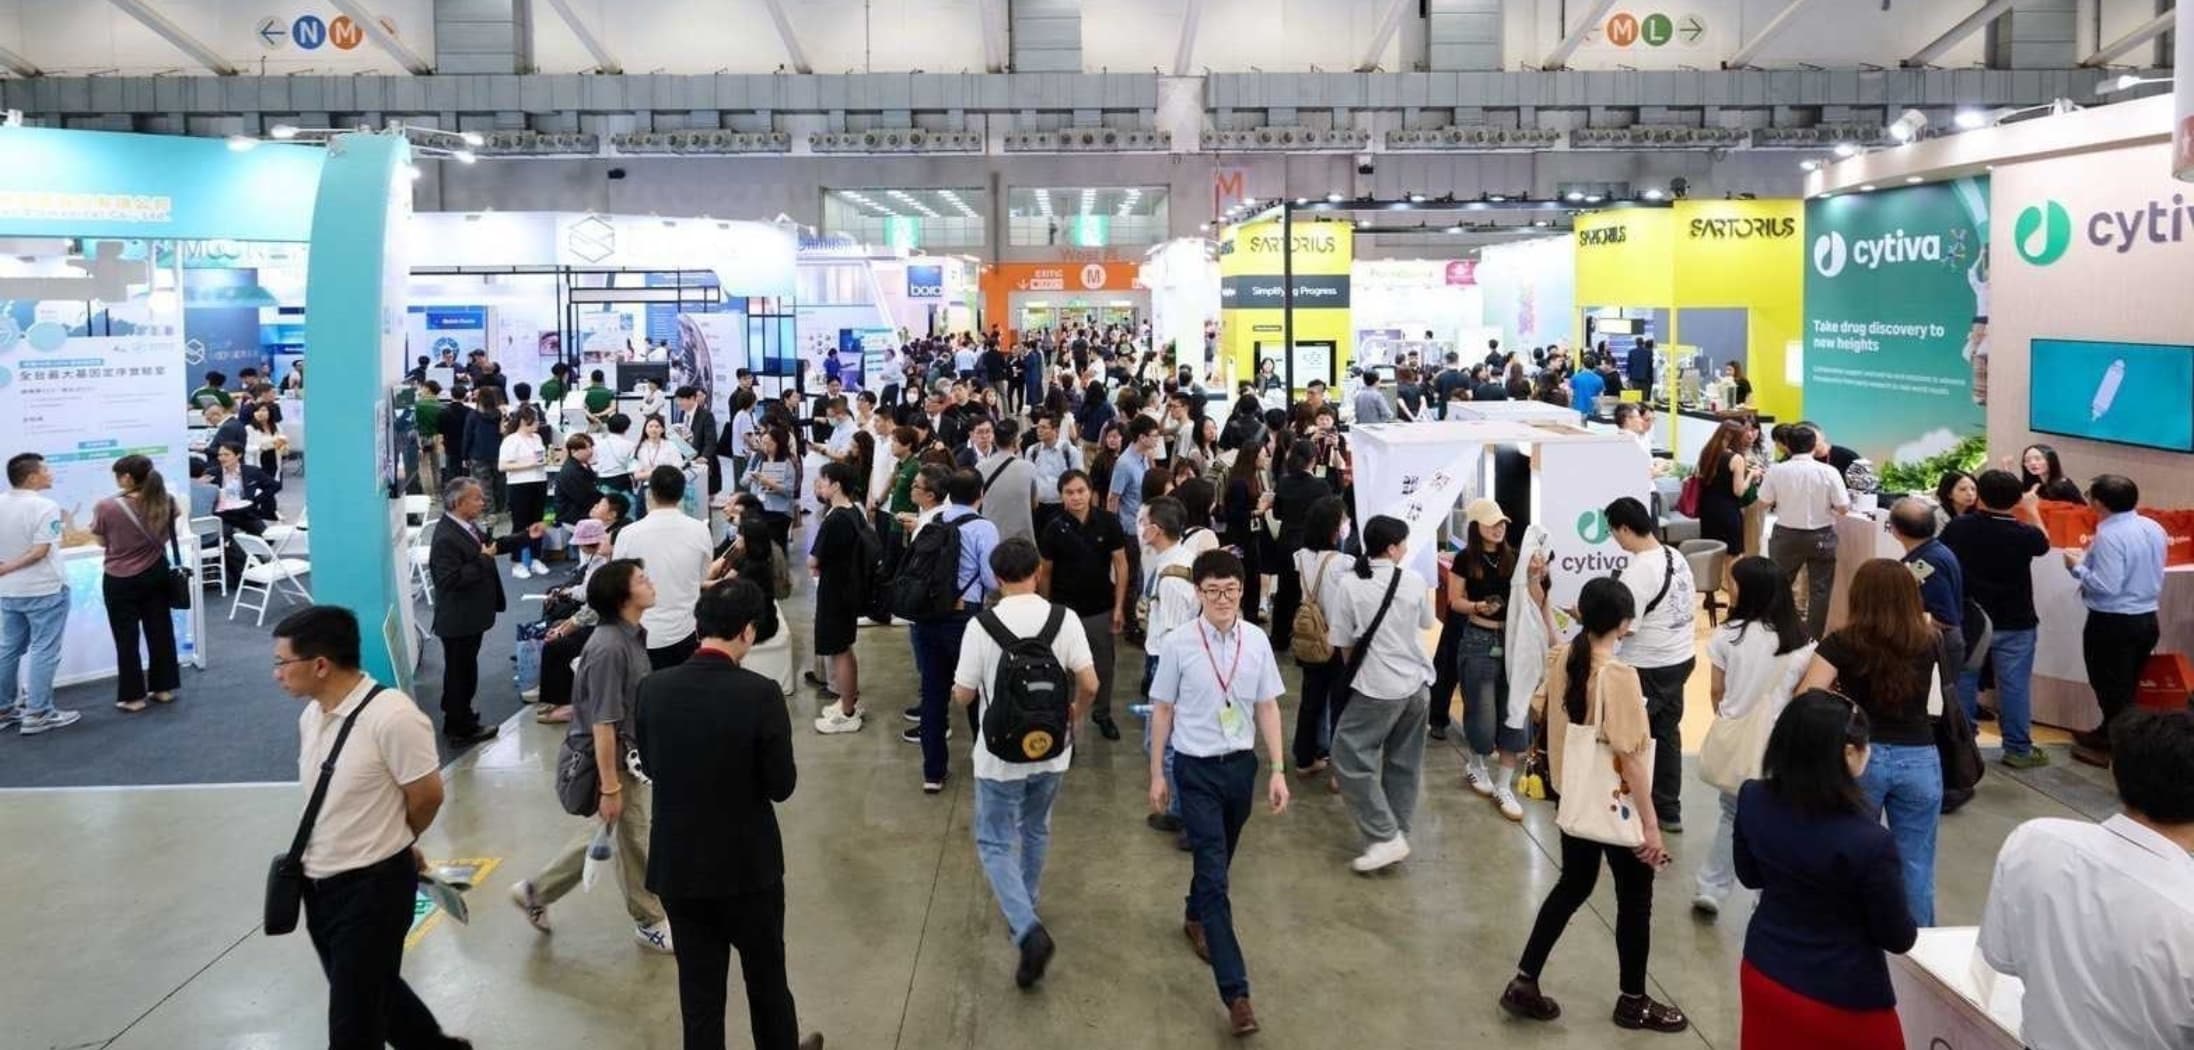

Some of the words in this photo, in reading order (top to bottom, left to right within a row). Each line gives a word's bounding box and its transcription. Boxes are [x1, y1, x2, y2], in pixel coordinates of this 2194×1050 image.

[299, 21, 319, 44] N
[335, 21, 358, 44] M
[1613, 19, 1634, 41] M
[1650, 19, 1664, 41] L
[1689, 216, 1796, 240] SARTORIUS
[2088, 193, 2194, 253] cyti
[1579, 225, 1627, 247] SARTORIUS
[1853, 228, 1941, 269] cytiva
[1086, 269, 1101, 285] M
[1813, 320, 1839, 333] Take
[1840, 321, 1867, 336] drug
[1868, 322, 1928, 339] discovery
[1930, 324, 1945, 337] to
[1813, 338, 1835, 349] new
[1836, 337, 1880, 353] heights
[1561, 551, 1629, 574] cytiva
